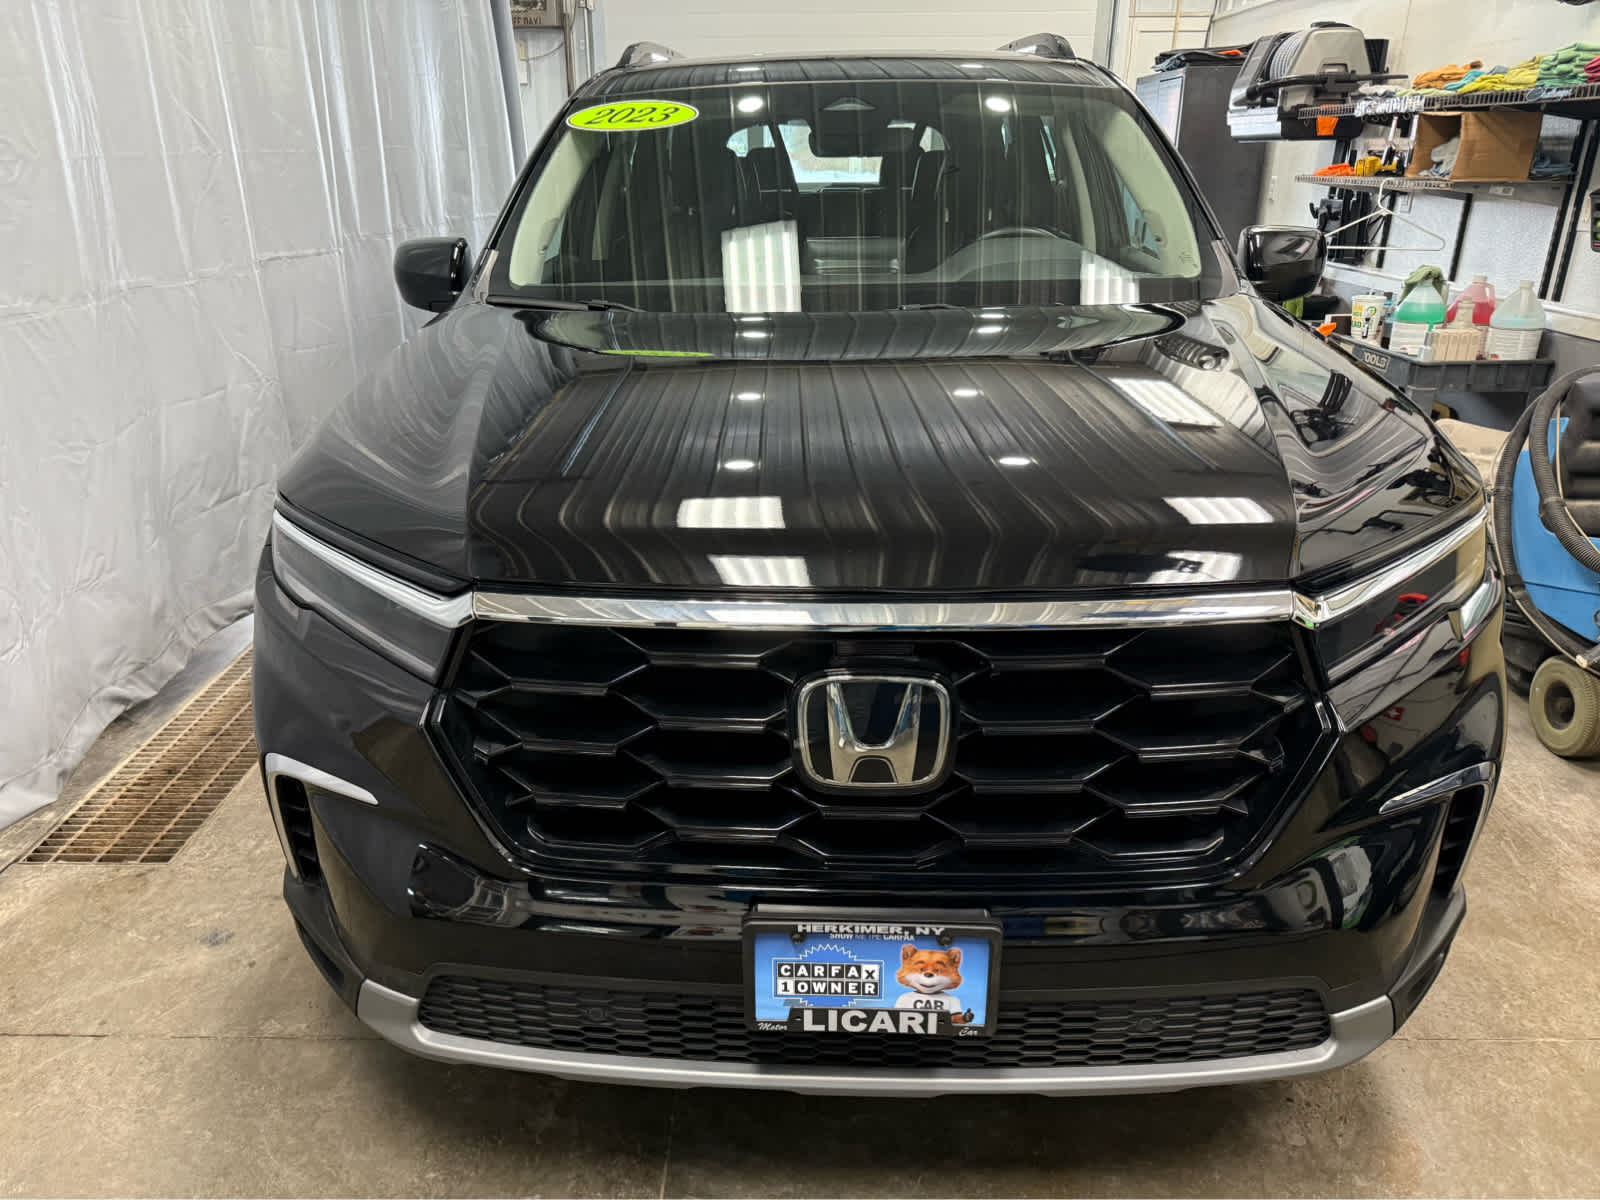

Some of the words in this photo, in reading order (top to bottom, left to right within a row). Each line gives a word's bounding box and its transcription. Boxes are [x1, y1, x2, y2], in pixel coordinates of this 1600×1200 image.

[584, 106, 681, 125] 2023
[797, 923, 909, 935] HERKIMER,
[915, 926, 946, 935] NY
[779, 964, 877, 980] CARFAX
[757, 1022, 788, 1031] Motor
[803, 1009, 938, 1034] LICARI
